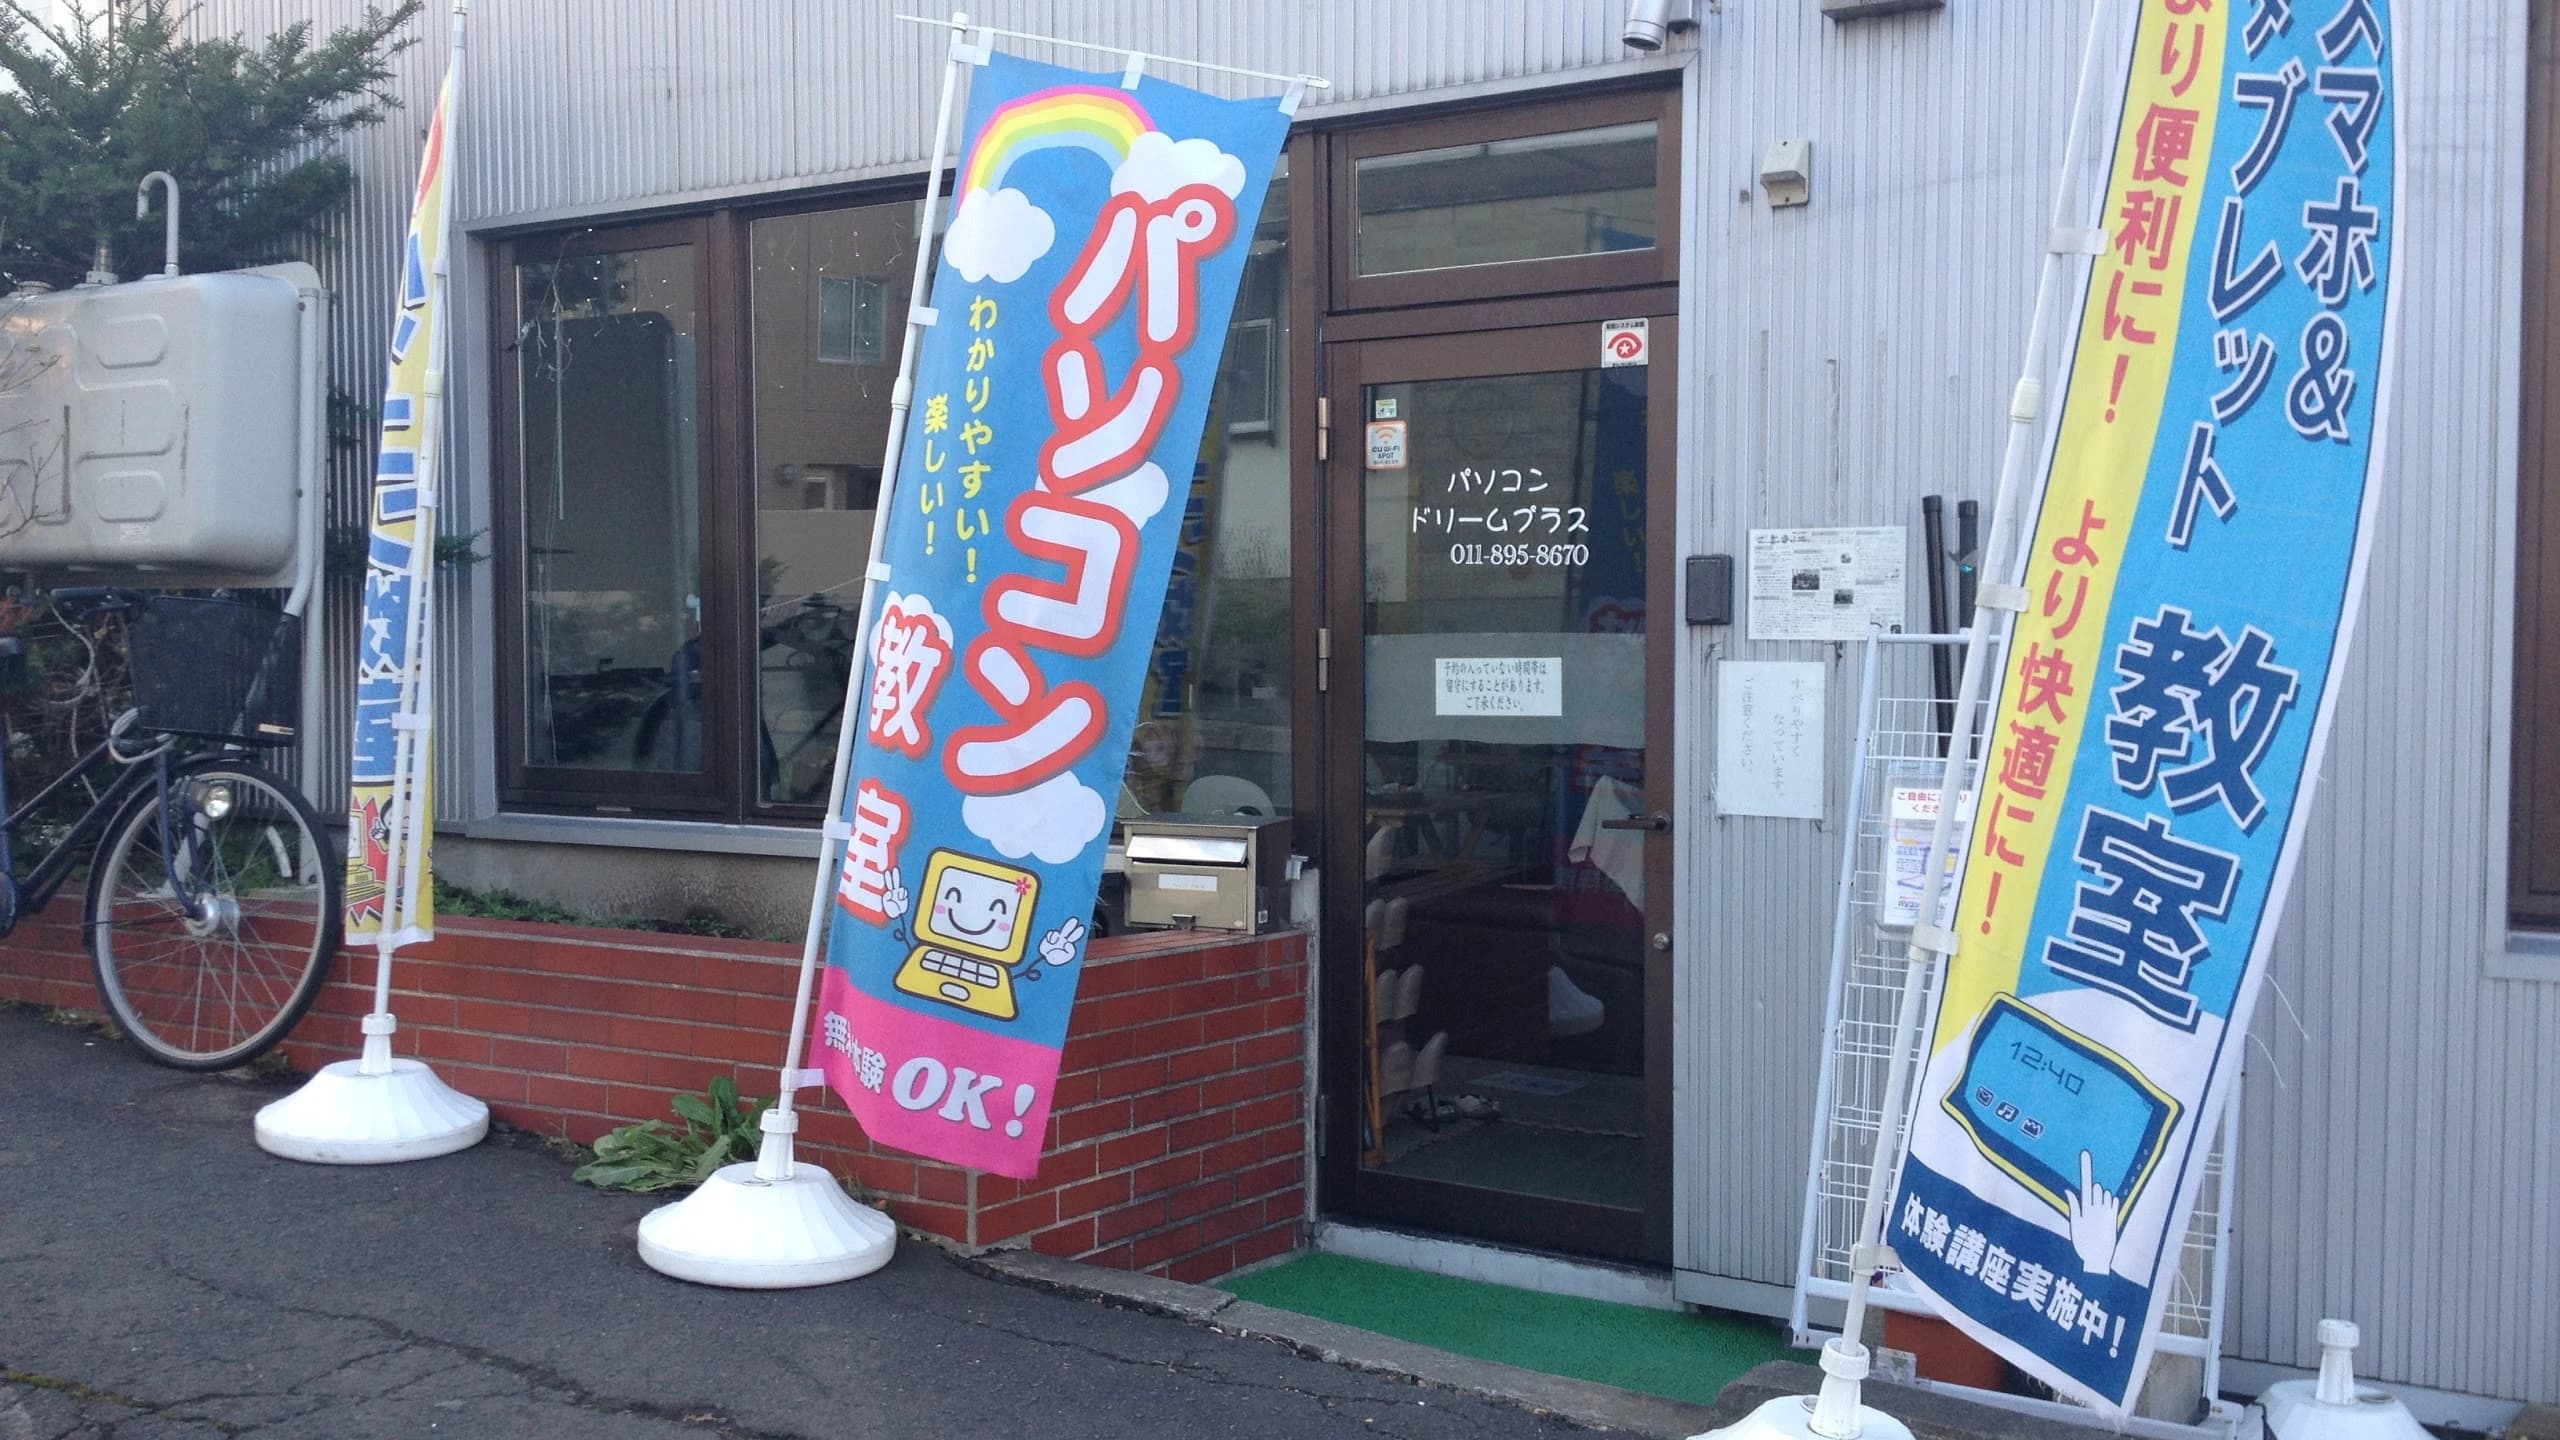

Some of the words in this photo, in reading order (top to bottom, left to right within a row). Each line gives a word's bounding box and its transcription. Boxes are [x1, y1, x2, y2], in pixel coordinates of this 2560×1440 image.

[2100, 0, 2212, 424] り便利に！
[918, 395, 949, 555] 楽しい！
[942, 183, 1236, 794] パソコン
[956, 295, 998, 584] わかりやすい！
[1412, 504, 1590, 533] ドリームプラス
[1447, 467, 1549, 494] パソコン
[1450, 543, 1590, 566] 011-895-8670
[1978, 499, 2106, 936] より快適に！
[2042, 603, 2304, 1034] 教室
[2009, 1038, 2085, 1096] 12:40
[1901, 1192, 2128, 1360] 体験講座実施中！
